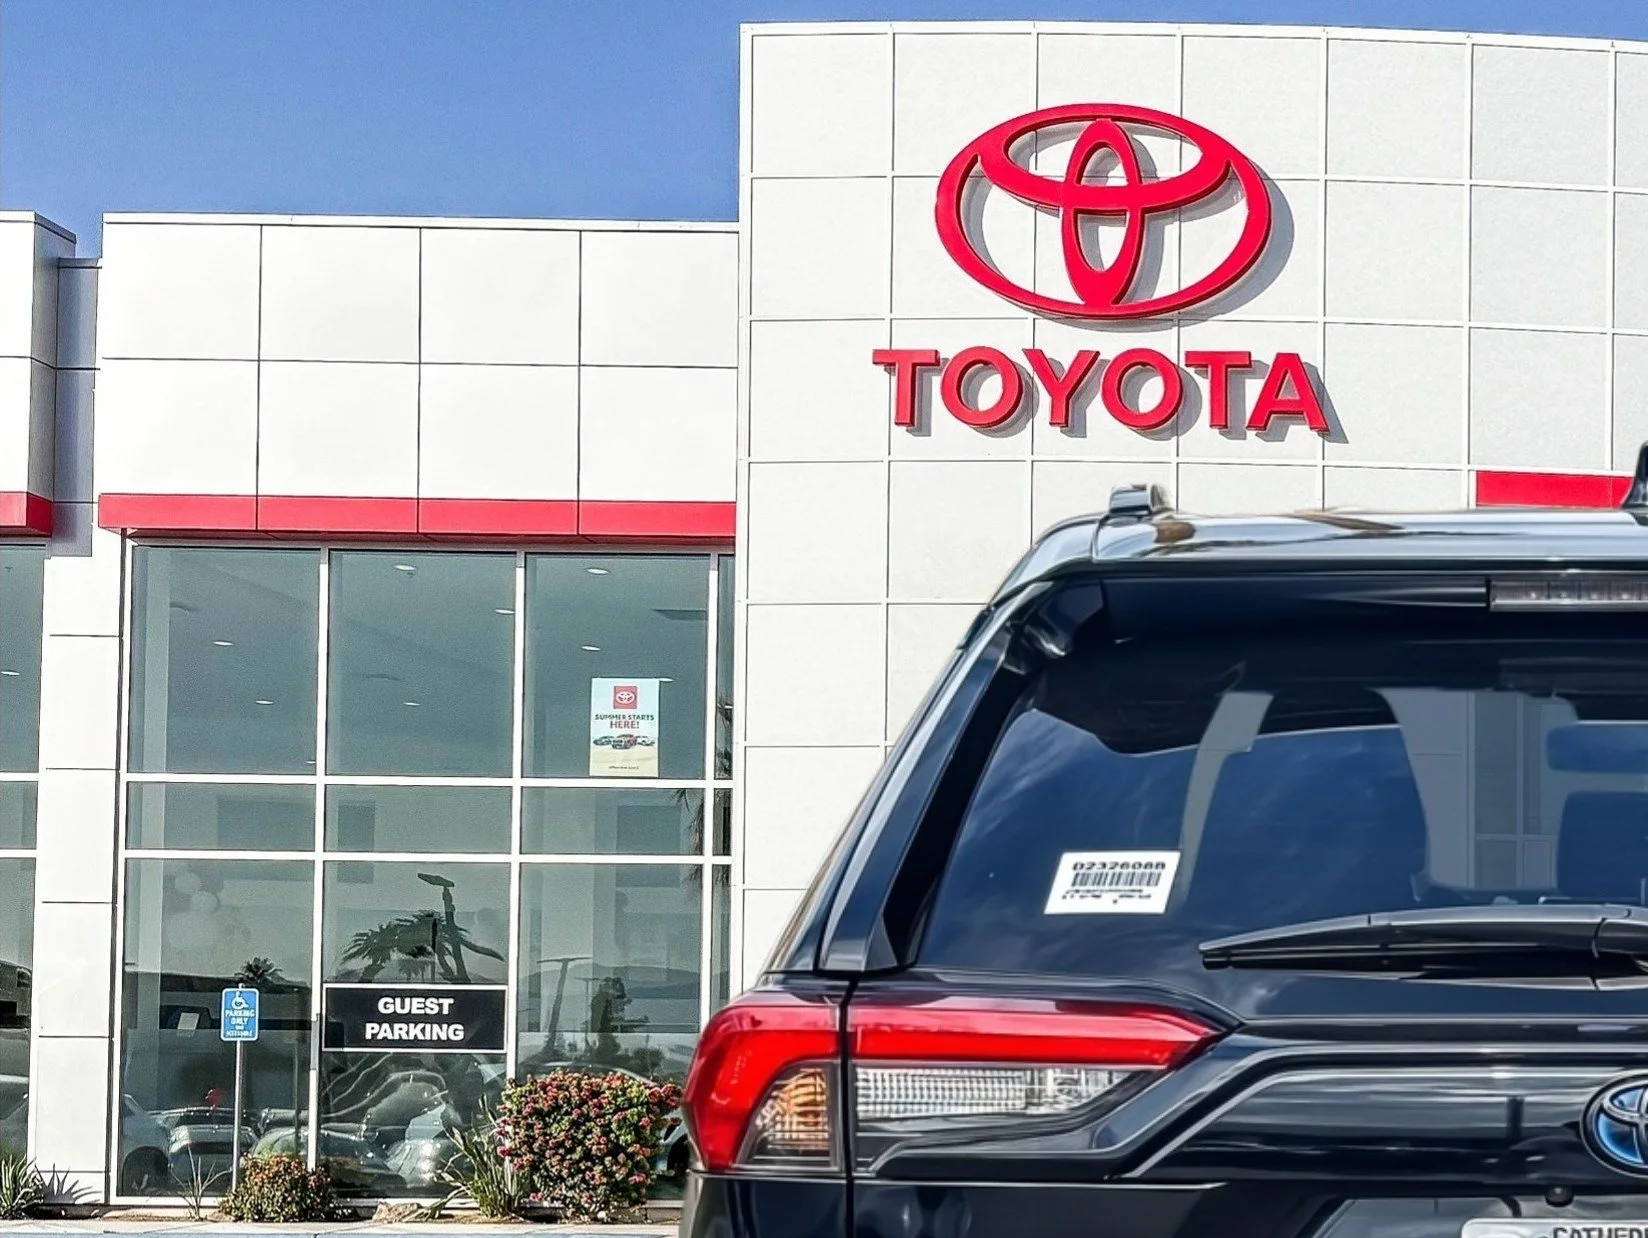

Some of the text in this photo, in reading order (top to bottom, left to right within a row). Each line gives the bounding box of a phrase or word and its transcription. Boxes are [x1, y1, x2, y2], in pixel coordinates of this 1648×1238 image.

[872, 345, 1331, 432] TOYOTA
[610, 720, 640, 729] HERE!
[377, 997, 454, 1014] GUEST
[225, 1009, 255, 1017] PARKING
[230, 1017, 249, 1025] ONLY
[364, 1022, 464, 1041] PARKING
